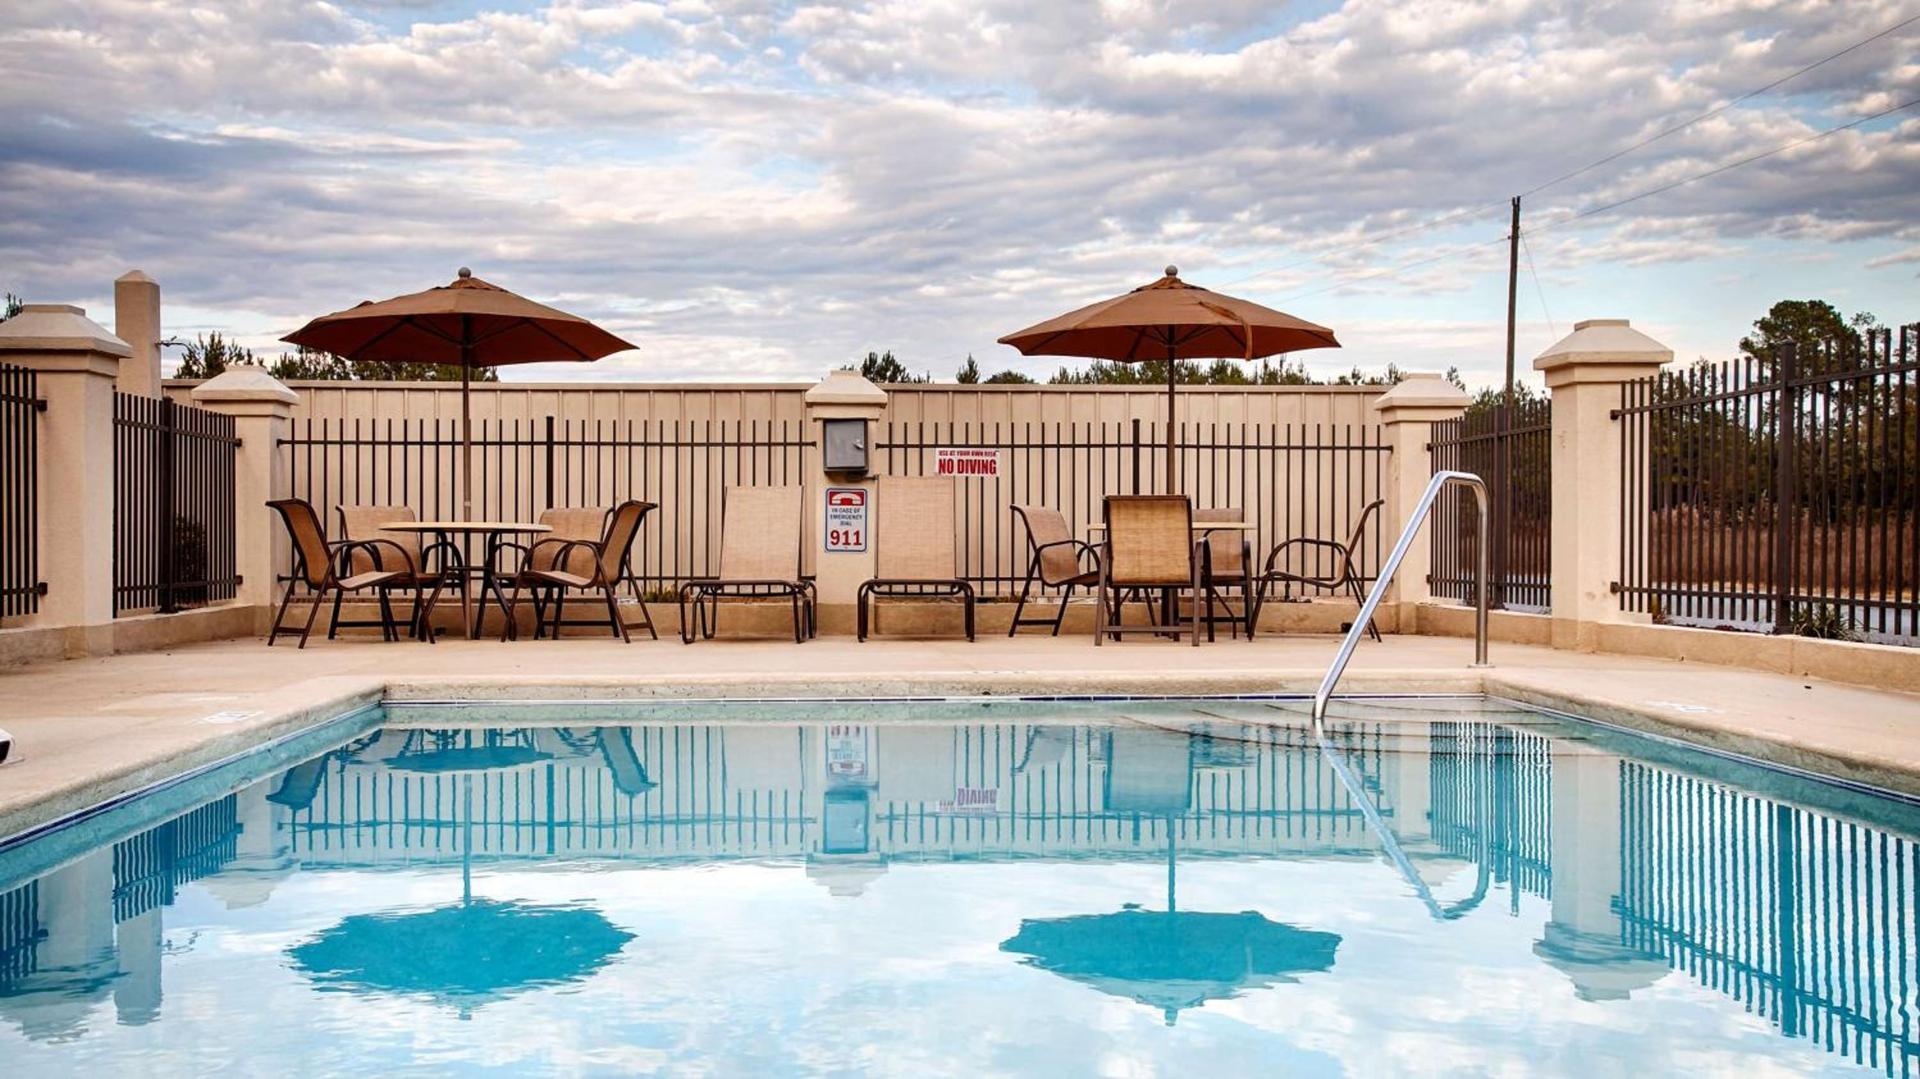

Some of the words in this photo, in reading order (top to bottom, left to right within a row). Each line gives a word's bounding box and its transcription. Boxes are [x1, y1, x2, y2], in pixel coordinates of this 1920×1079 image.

[939, 459, 954, 474] NO
[957, 459, 997, 474] DIVING
[830, 529, 863, 546] 911
